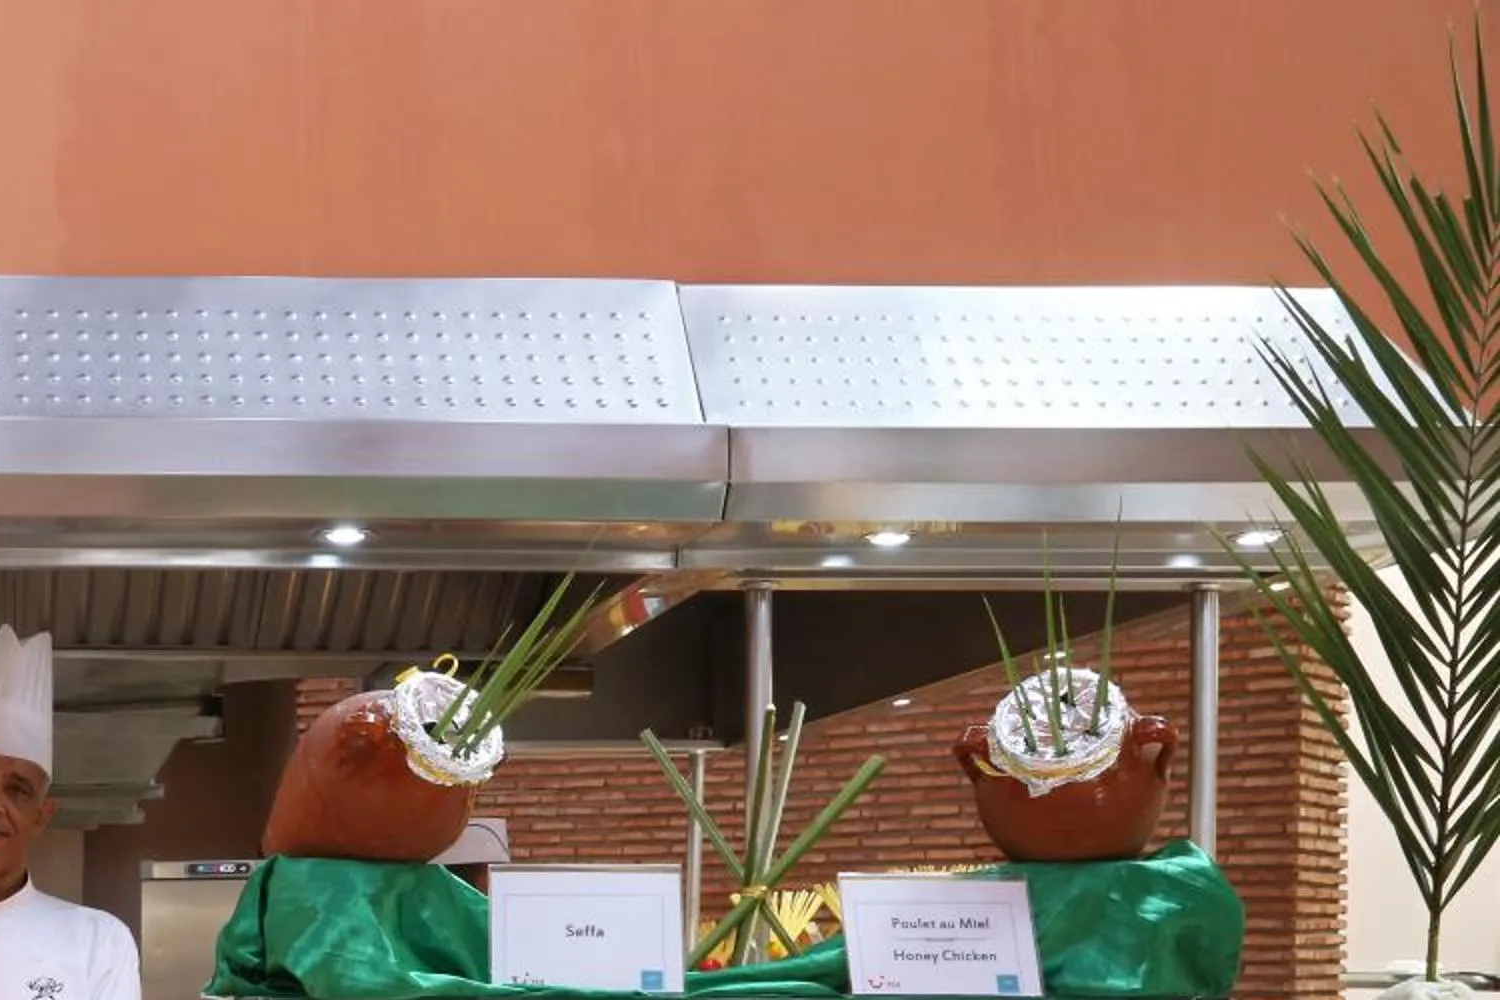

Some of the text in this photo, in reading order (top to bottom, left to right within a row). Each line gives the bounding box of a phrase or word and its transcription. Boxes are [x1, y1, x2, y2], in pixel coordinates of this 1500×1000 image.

[891, 917, 990, 929] Poulet au Miel
[565, 924, 605, 937] Seffa
[893, 949, 997, 965] Honey Chicken
